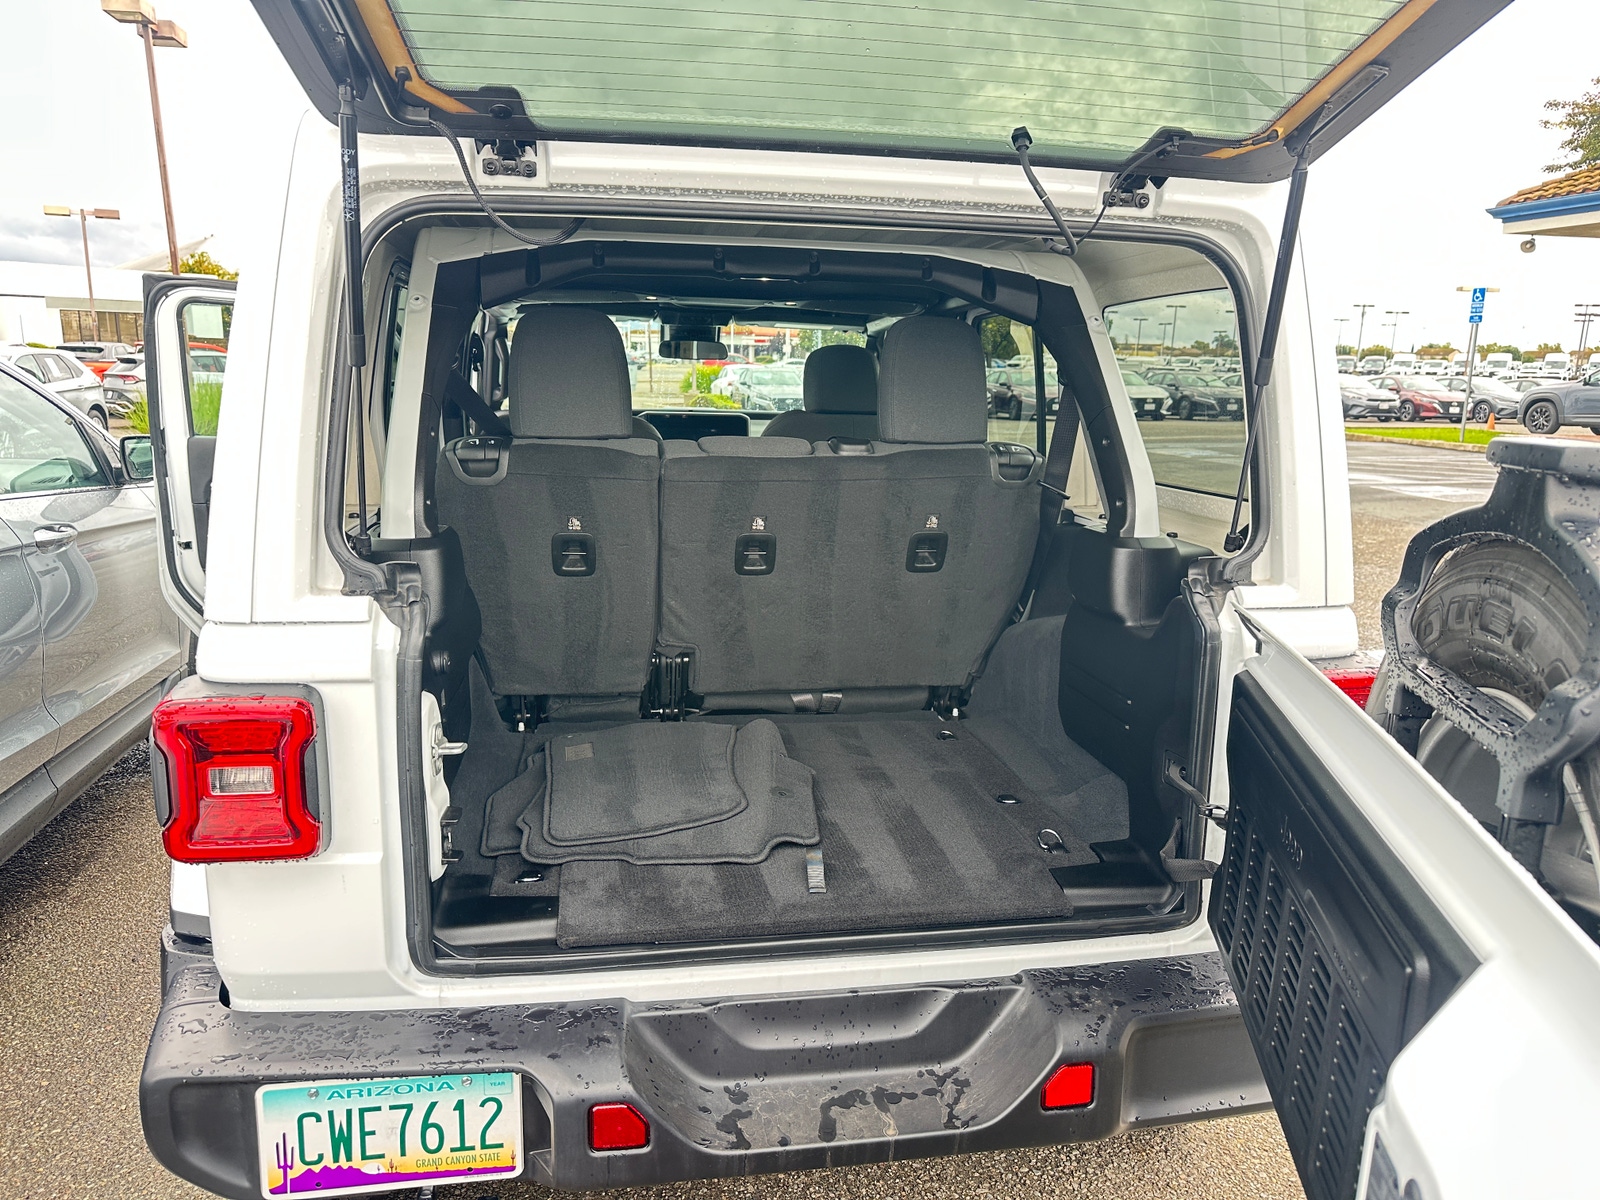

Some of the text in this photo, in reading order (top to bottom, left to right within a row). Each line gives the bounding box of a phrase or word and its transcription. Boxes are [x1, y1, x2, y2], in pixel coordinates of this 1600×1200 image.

[326, 1080, 455, 1101] ARIZONA
[297, 1096, 505, 1167] CWE7612
[415, 1152, 501, 1169] GRAND CANYON STATE
